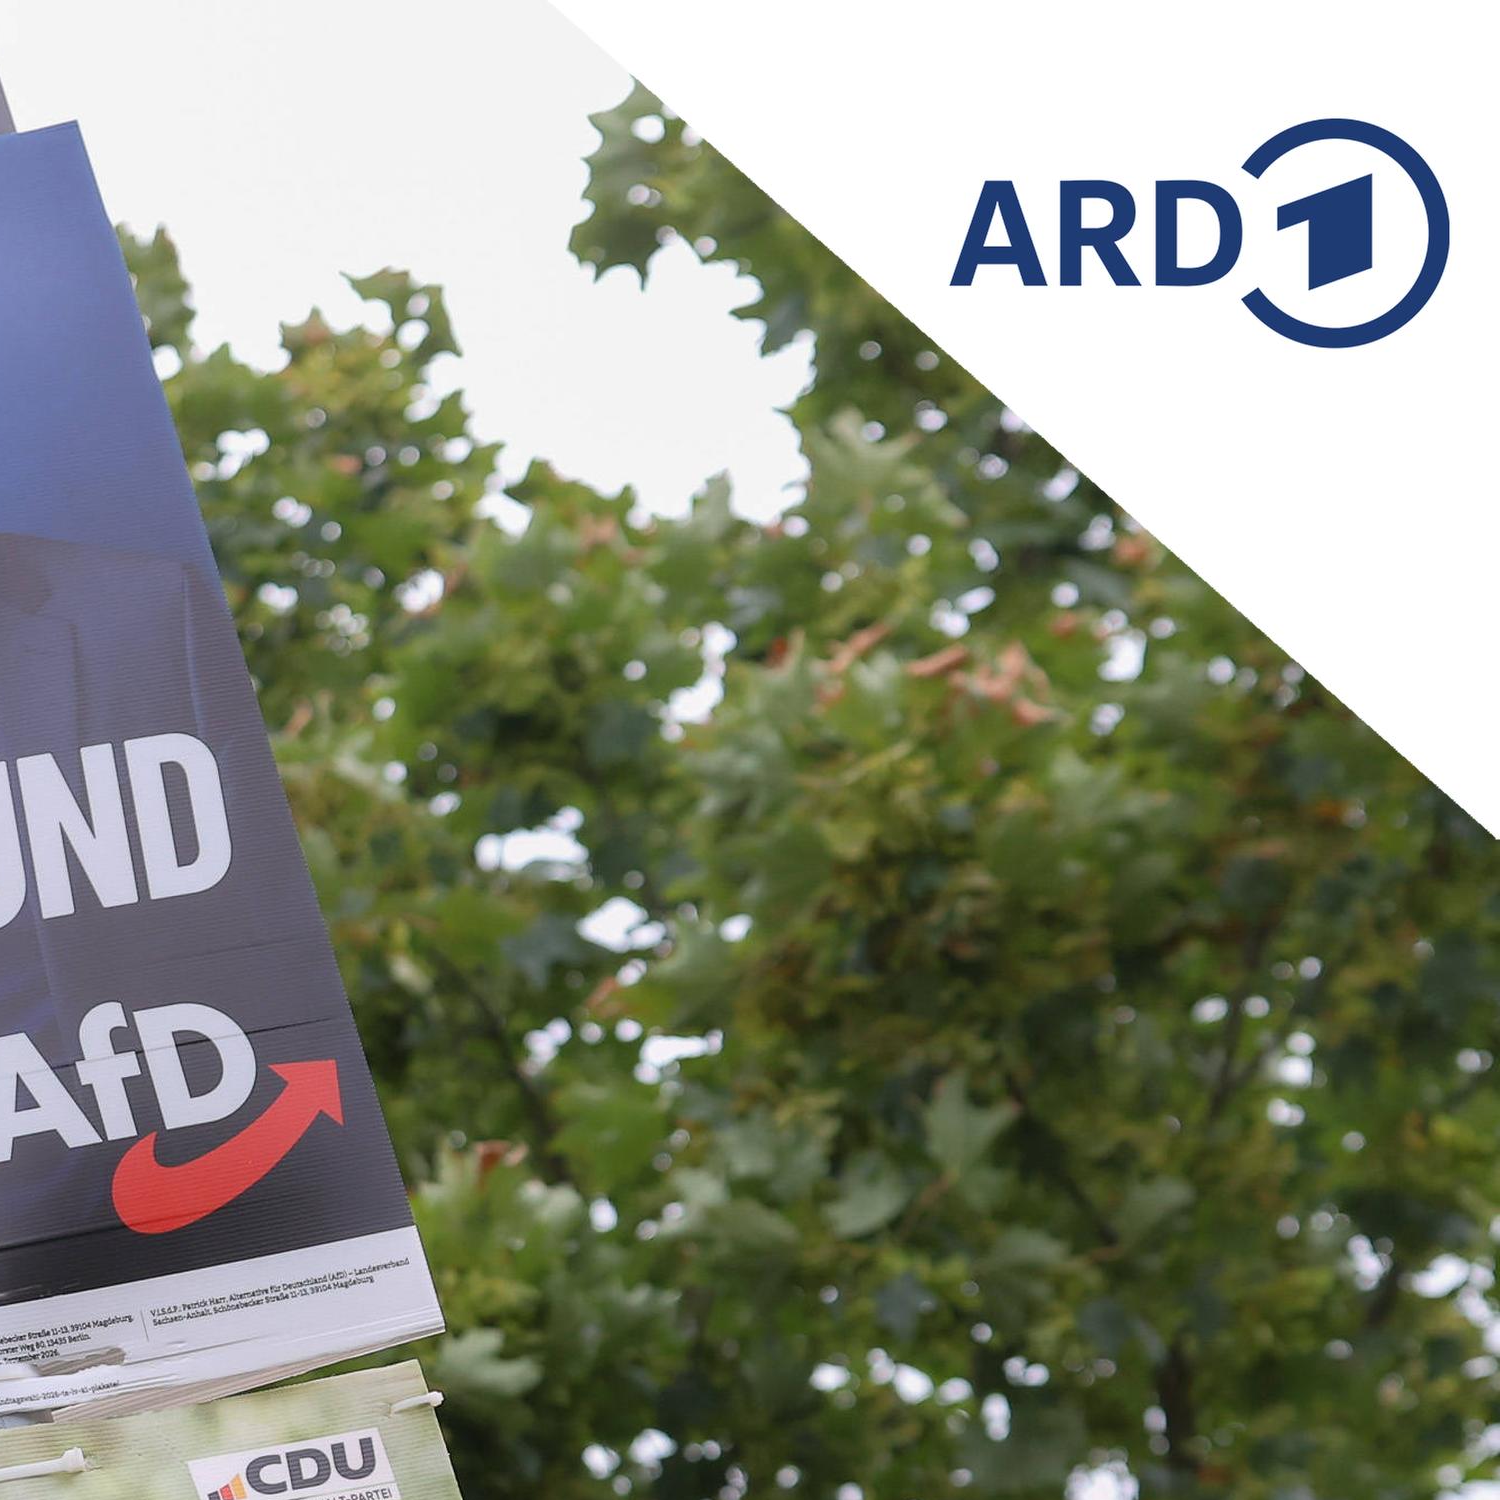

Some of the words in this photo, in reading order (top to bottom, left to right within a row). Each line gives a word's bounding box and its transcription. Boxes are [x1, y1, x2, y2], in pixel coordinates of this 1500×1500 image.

[152, 1308, 212, 1326] Sachsen-Anhalt,
[213, 1298, 264, 1314] Schönebecker
[264, 1291, 290, 1303] Straße
[310, 1284, 332, 1294] 39104
[333, 1275, 375, 1290] Magdeburg
[181, 1299, 208, 1311] Patrick
[229, 1288, 269, 1302] Alternative
[269, 1285, 281, 1293] für
[282, 1275, 327, 1291] Deutschland
[328, 1270, 347, 1282] (AfD)
[354, 1257, 410, 1276] Landesverband
[19, 1343, 35, 1353] Weg
[46, 1336, 67, 1347] 13435
[27, 1328, 51, 1340] Straße
[70, 1321, 92, 1333] 39104
[246, 1436, 376, 1495] CDU
